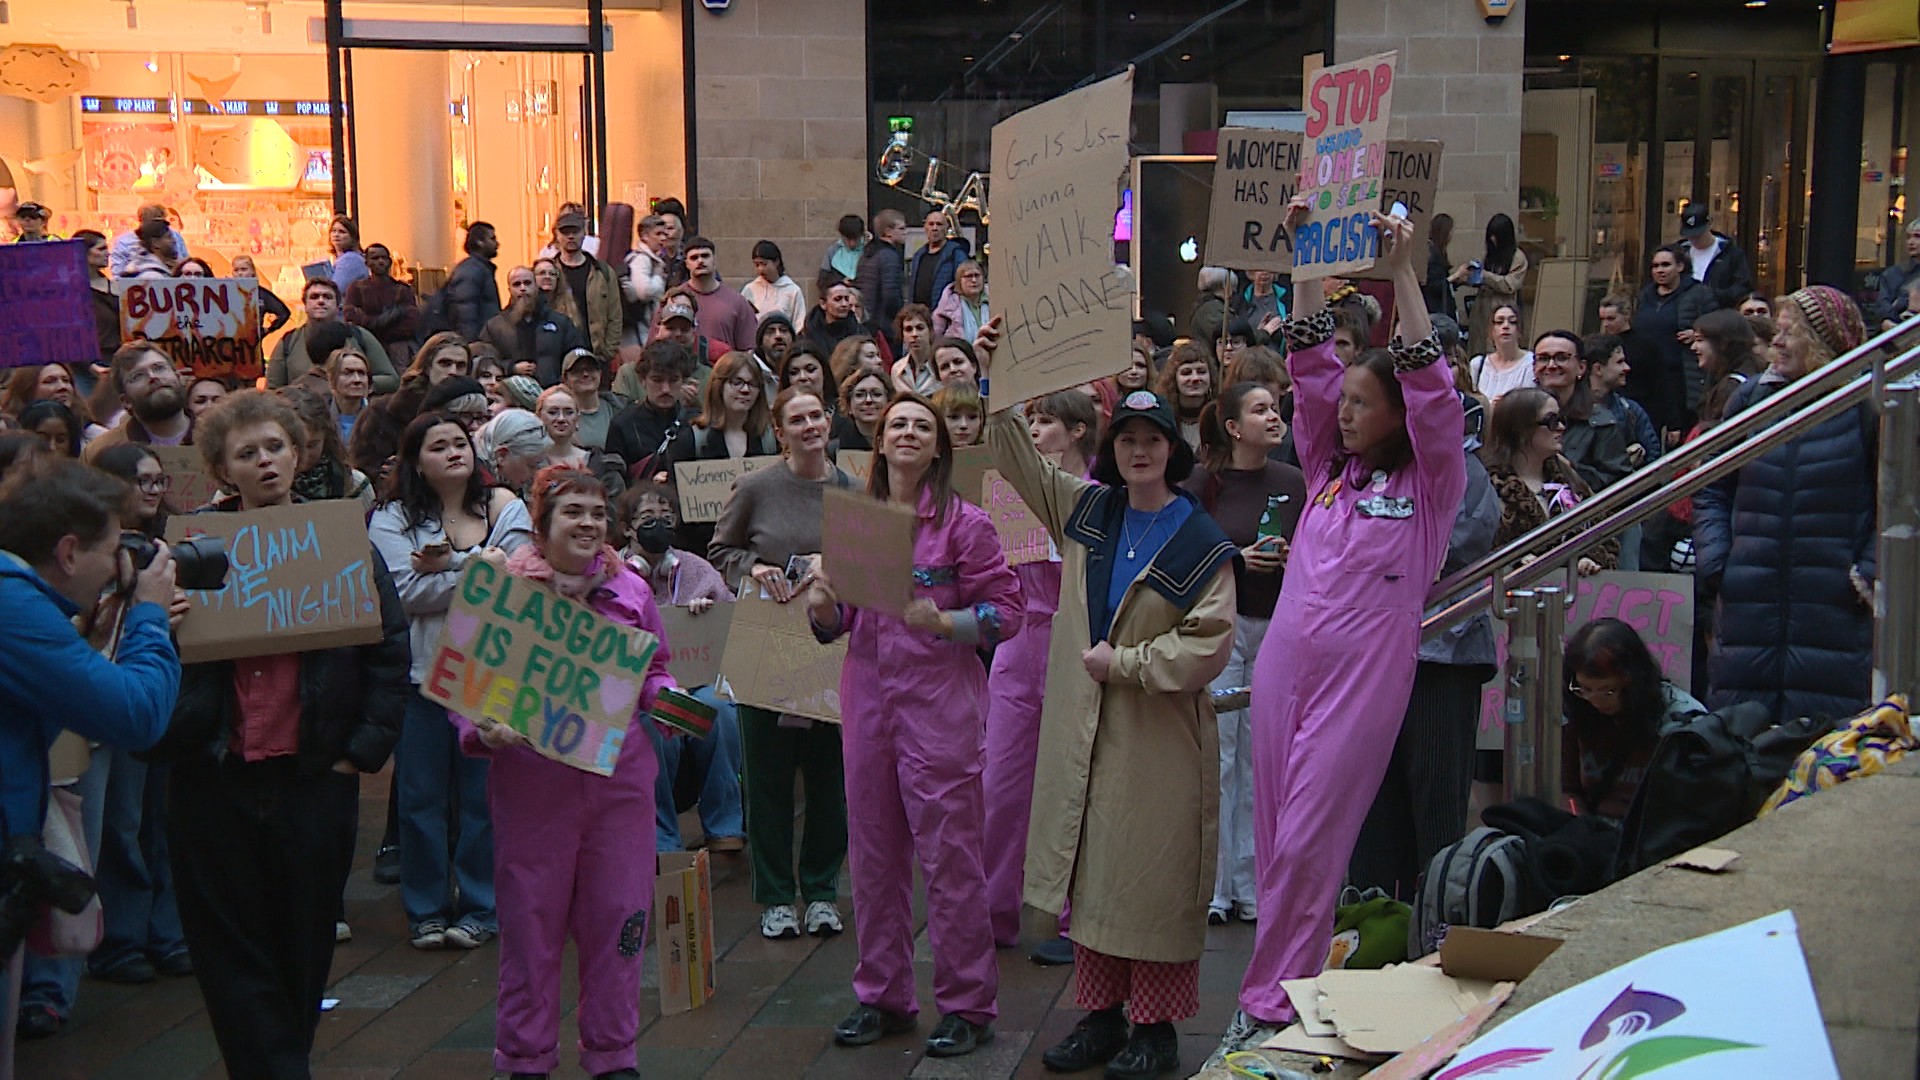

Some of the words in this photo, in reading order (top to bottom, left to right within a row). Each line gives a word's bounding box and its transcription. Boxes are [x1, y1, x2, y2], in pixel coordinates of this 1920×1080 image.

[117, 98, 132, 112] POP
[133, 98, 155, 112] MART
[226, 101, 247, 113] MART
[296, 102, 311, 114] POP
[312, 102, 330, 114] MAR
[1305, 63, 1392, 138] STOP
[1226, 138, 1301, 171] WOMEN
[1384, 151, 1432, 181] TION
[1315, 127, 1363, 154] USING
[1300, 143, 1385, 192] WOMEN
[1234, 179, 1269, 206] HAS
[1336, 179, 1378, 210] SELL
[1293, 211, 1379, 268] RACISM
[127, 283, 229, 319] BURN
[1005, 271, 1126, 363] HOME
[176, 315, 203, 330] the
[133, 330, 260, 369] TRIARCHY
[266, 559, 375, 633] NIGHT!
[463, 560, 659, 674] GLASGOW
[474, 622, 513, 668] IS
[521, 643, 601, 713] FOR
